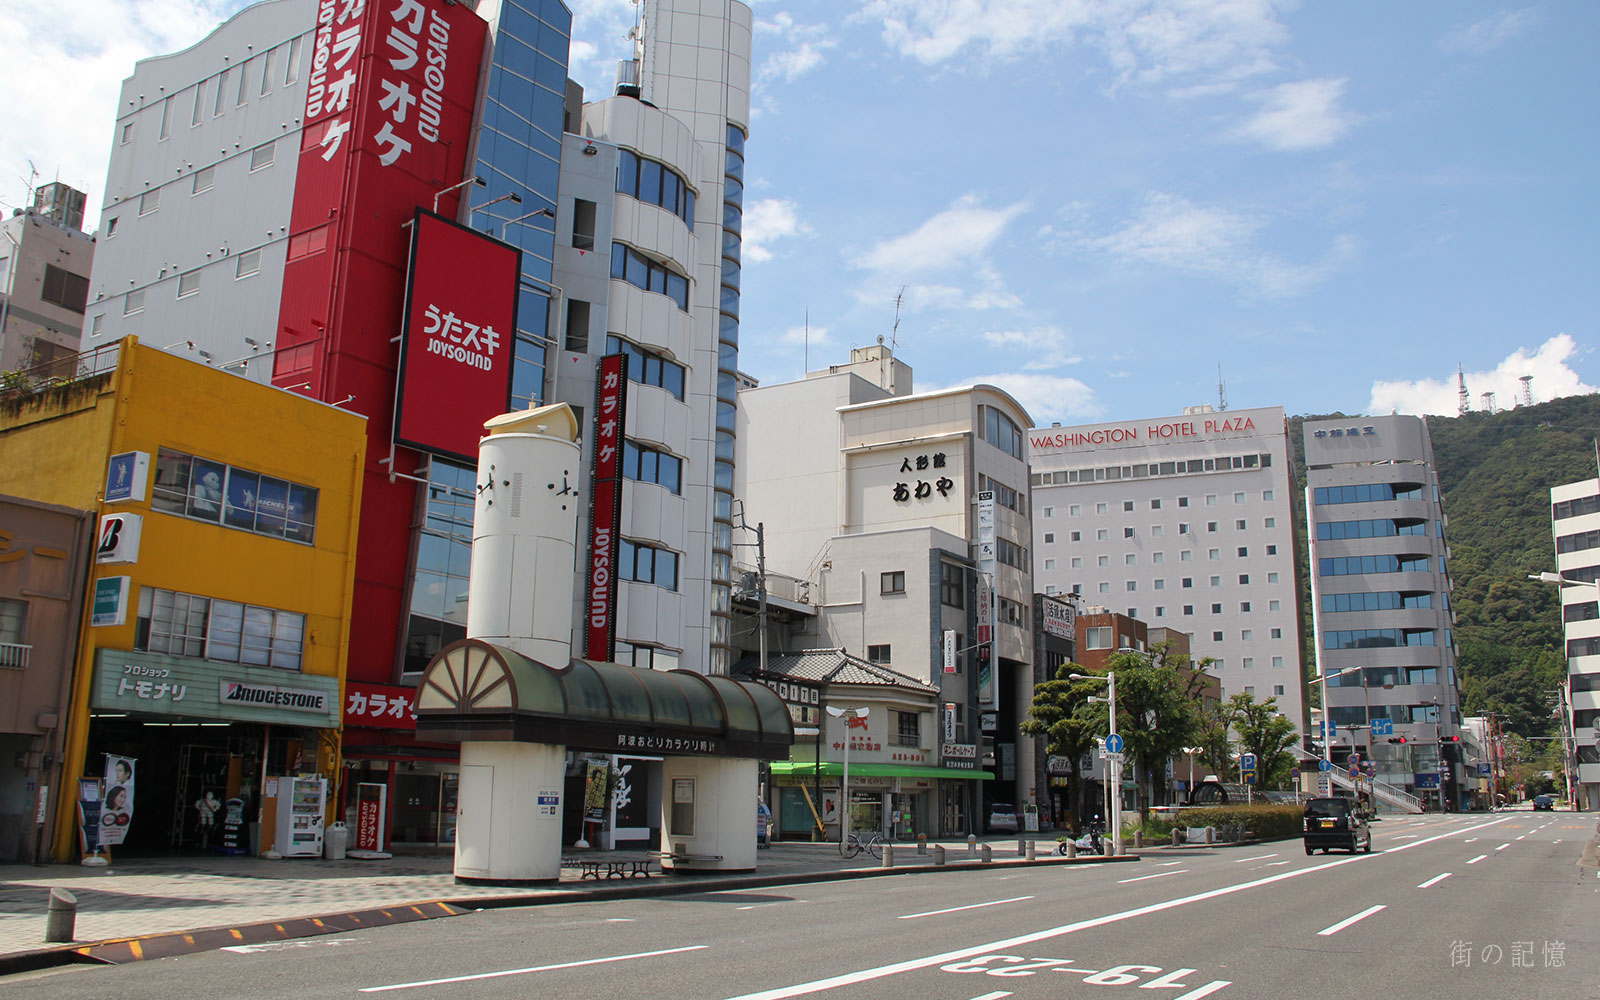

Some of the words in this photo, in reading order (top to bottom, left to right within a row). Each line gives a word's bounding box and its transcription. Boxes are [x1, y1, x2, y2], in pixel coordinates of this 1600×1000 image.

[374, 0, 426, 167] カラオケ
[418, 9, 450, 143] JOYSOUND
[423, 303, 500, 356] うたスキ
[427, 338, 492, 372] JOYSOUND
[600, 372, 618, 463] カラオケ
[1029, 427, 1137, 449] WASHINGTON
[1148, 422, 1197, 439] HOTEL
[1204, 416, 1256, 434] PLAZA
[900, 452, 946, 473] 人形館
[257, 498, 295, 511] MICHELN
[892, 476, 954, 502] あわや
[591, 527, 610, 629] JOYSOUND
[117, 678, 187, 701] トモナリ
[226, 683, 324, 709] BRIDGESTONE
[1245, 756, 1253, 768] P
[367, 803, 377, 847] カラオケ
[940, 955, 1198, 989] 19-23
